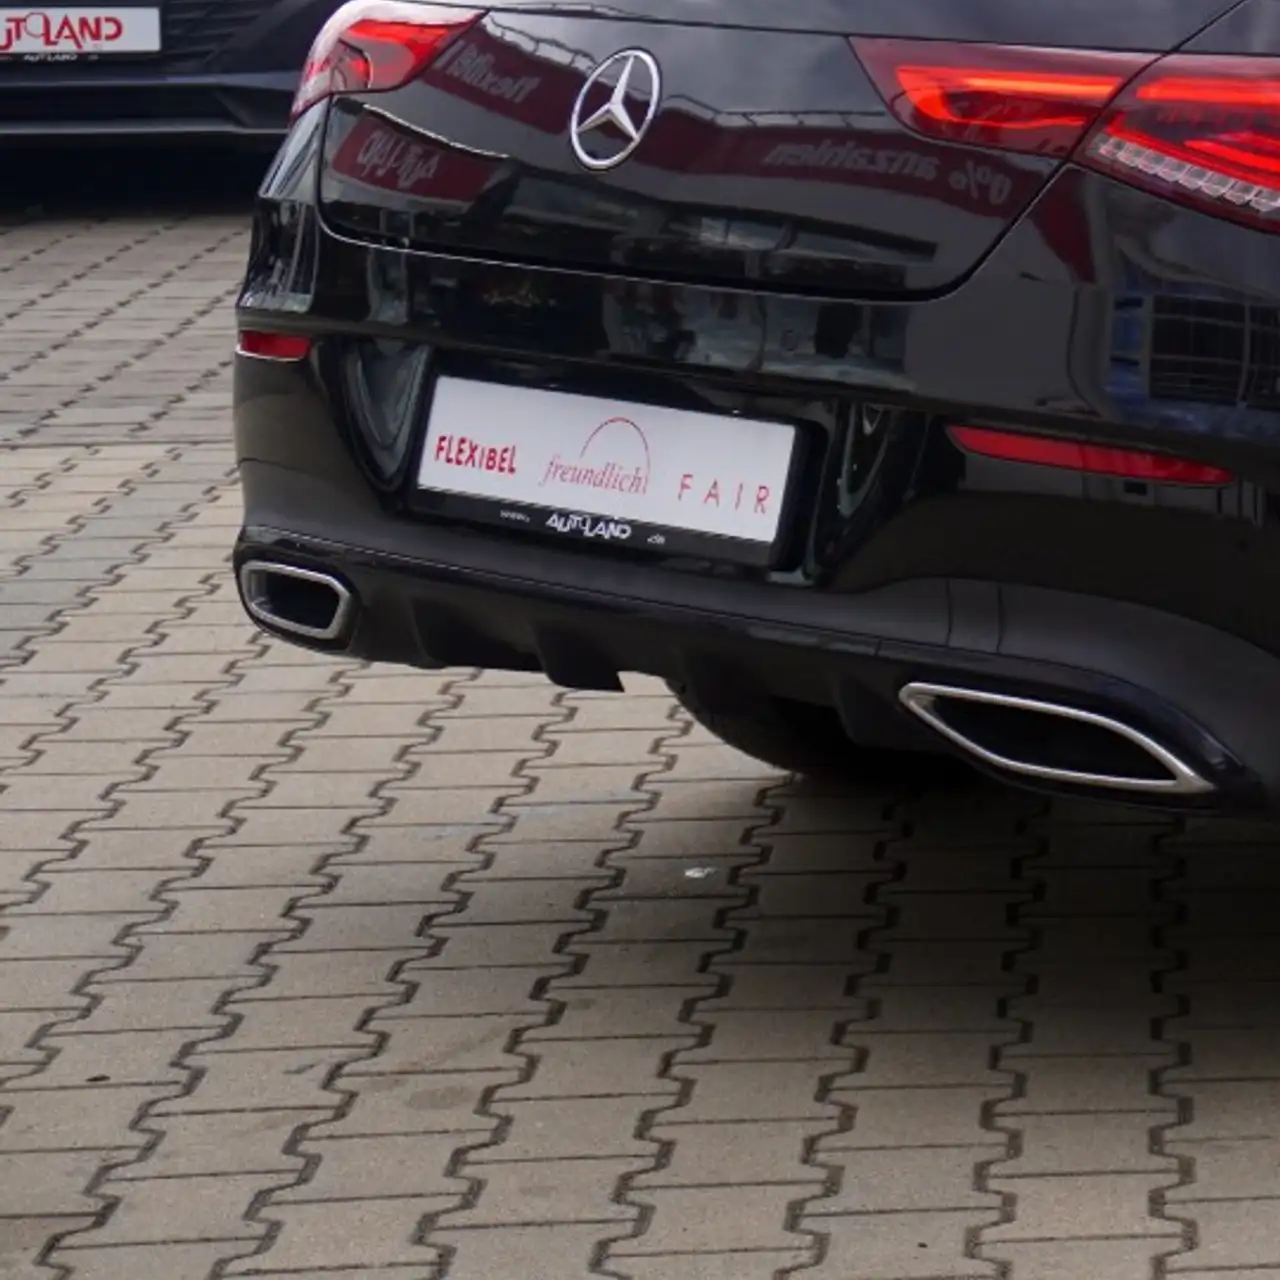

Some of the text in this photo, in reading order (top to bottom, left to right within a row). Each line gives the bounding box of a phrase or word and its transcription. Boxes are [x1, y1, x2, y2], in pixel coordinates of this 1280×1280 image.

[0, 11, 124, 50] UTOLAND
[435, 435, 771, 515] FLEXIBEL freundlich FAIR
[545, 512, 633, 540] AUTOLAND
